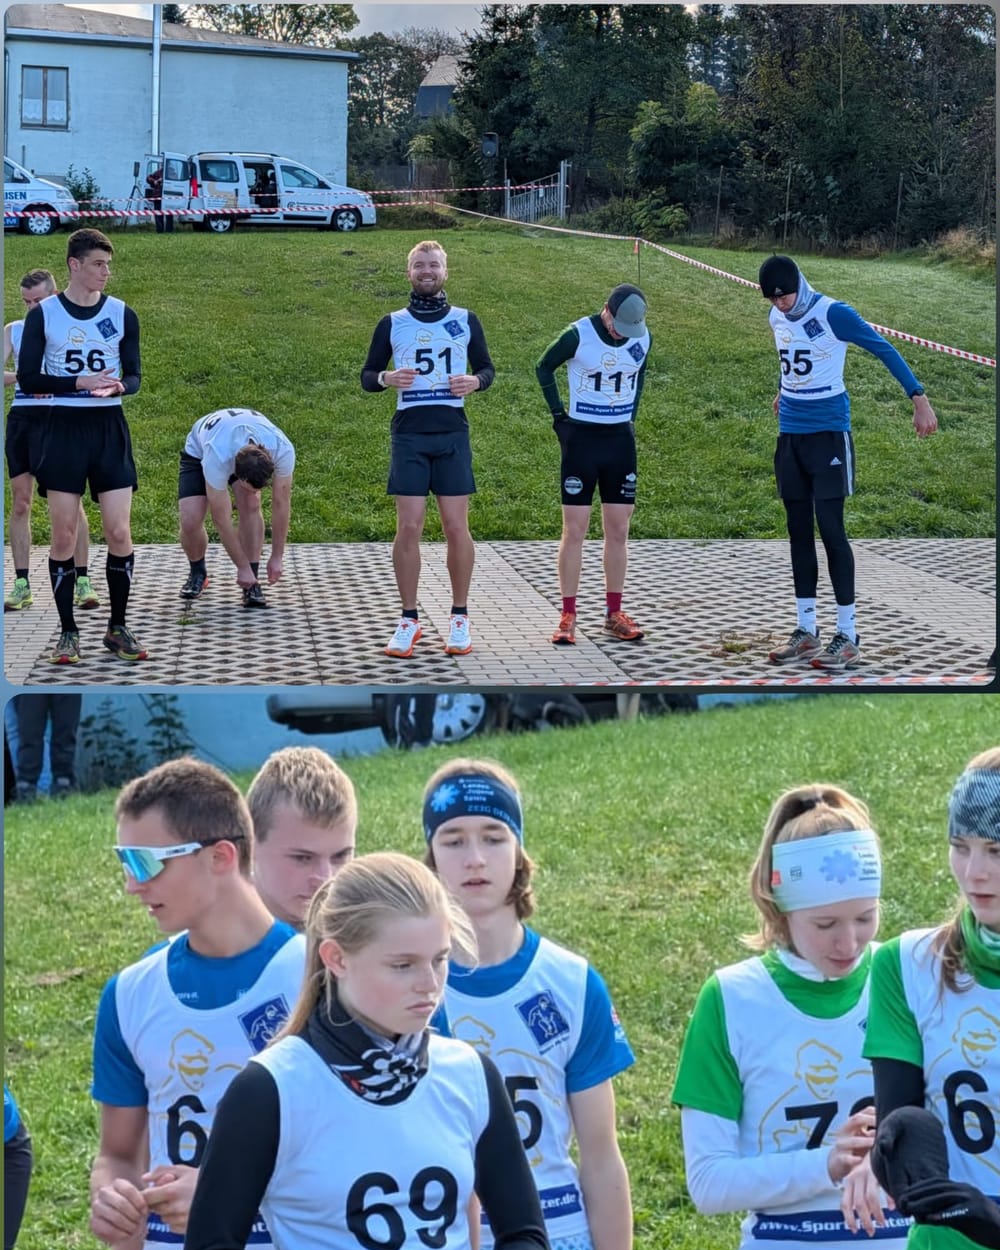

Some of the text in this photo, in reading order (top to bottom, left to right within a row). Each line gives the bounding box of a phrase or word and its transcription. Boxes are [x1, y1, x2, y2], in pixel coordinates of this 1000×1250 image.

[65, 349, 106, 374] 56
[415, 347, 452, 375] 51
[779, 350, 813, 376] 55
[587, 371, 637, 392] 111
[505, 1076, 543, 1150] 5
[167, 1094, 208, 1169] 6
[540, 1192, 577, 1210] ter.de
